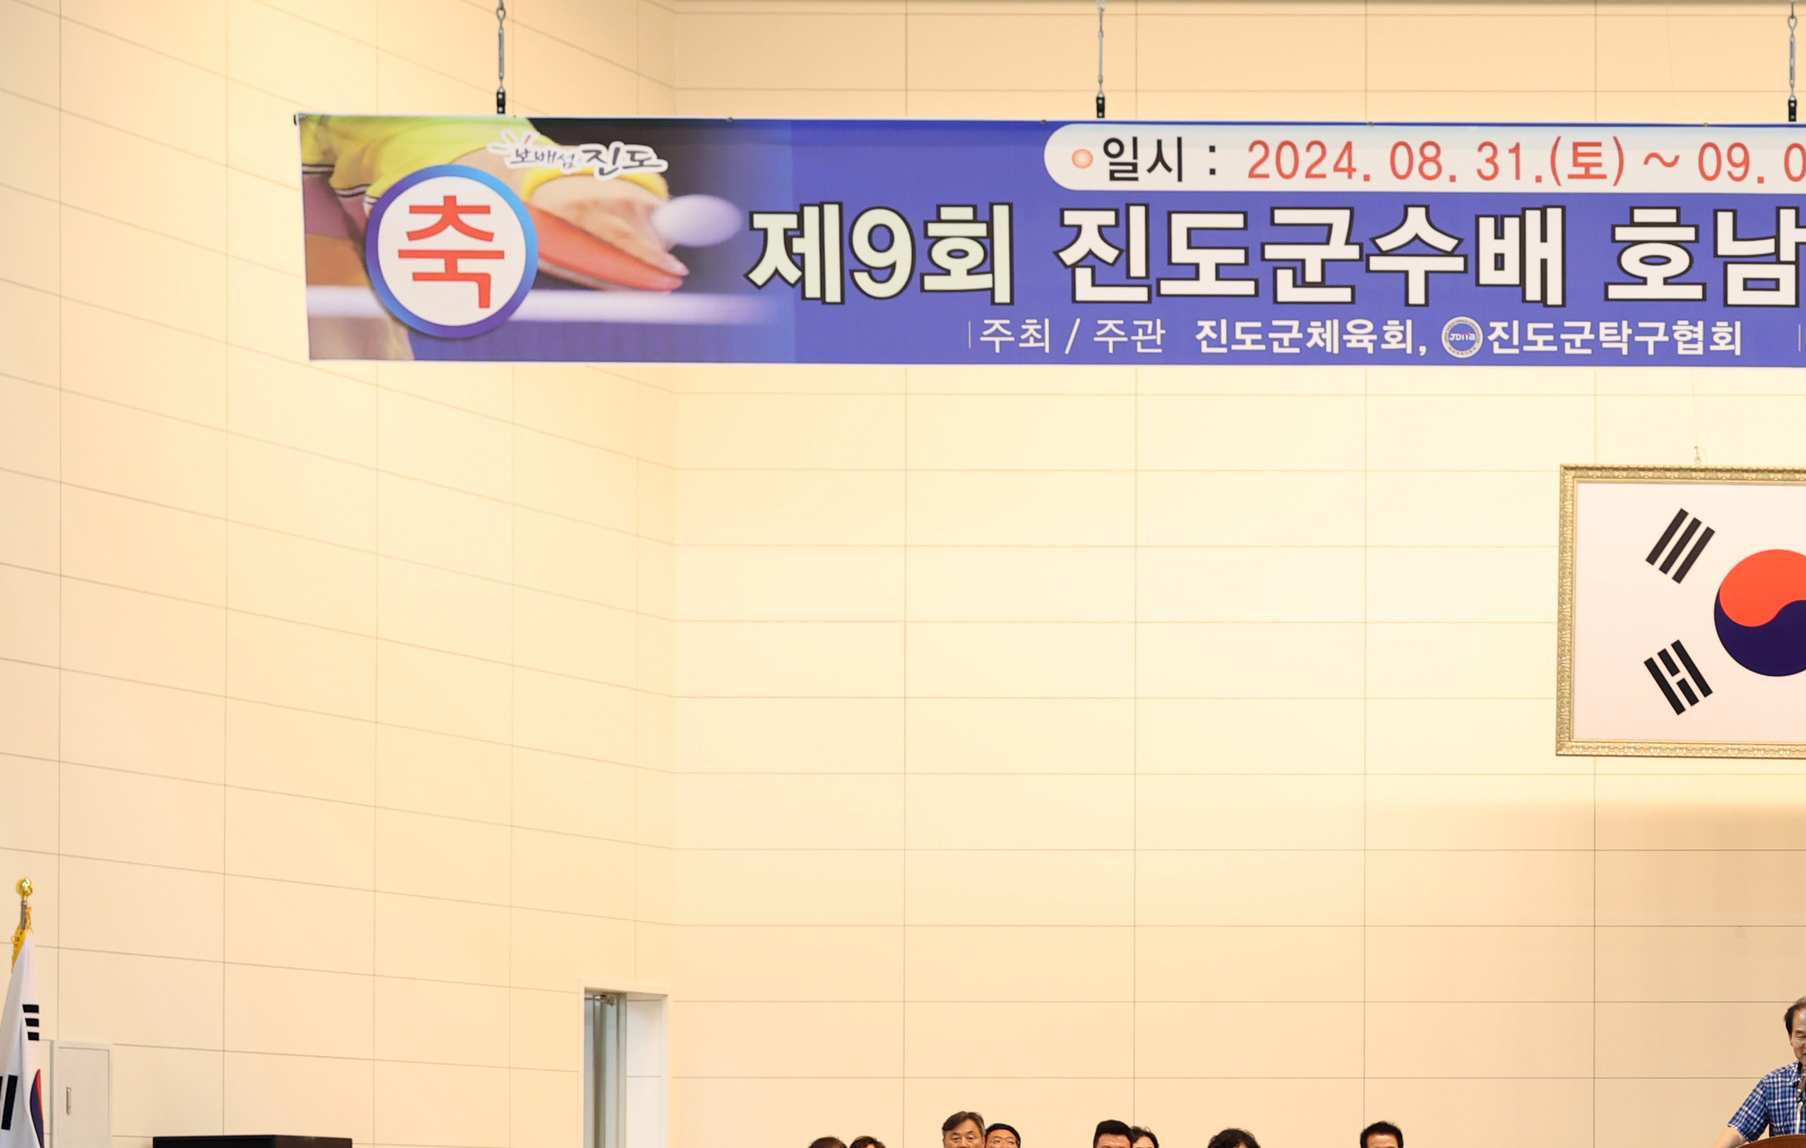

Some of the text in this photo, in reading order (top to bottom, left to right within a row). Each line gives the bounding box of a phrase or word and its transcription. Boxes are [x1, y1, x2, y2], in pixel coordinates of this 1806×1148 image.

[510, 146, 663, 176] 보배섬 진도
[1102, 136, 1185, 183] 일시
[1247, 139, 1372, 183] 2024.
[1389, 140, 1457, 183] 08.
[1476, 136, 1626, 187] 31.(토)
[1697, 141, 1765, 184] 09.
[397, 194, 506, 310] 축
[747, 201, 1014, 305] 제9회
[1054, 203, 1566, 308] 진도군수배
[979, 318, 1051, 354] 주최
[1093, 318, 1167, 354] 주관
[1195, 318, 1428, 357] 진도군체육회,
[1486, 319, 1743, 356] 진도군탁구협회
